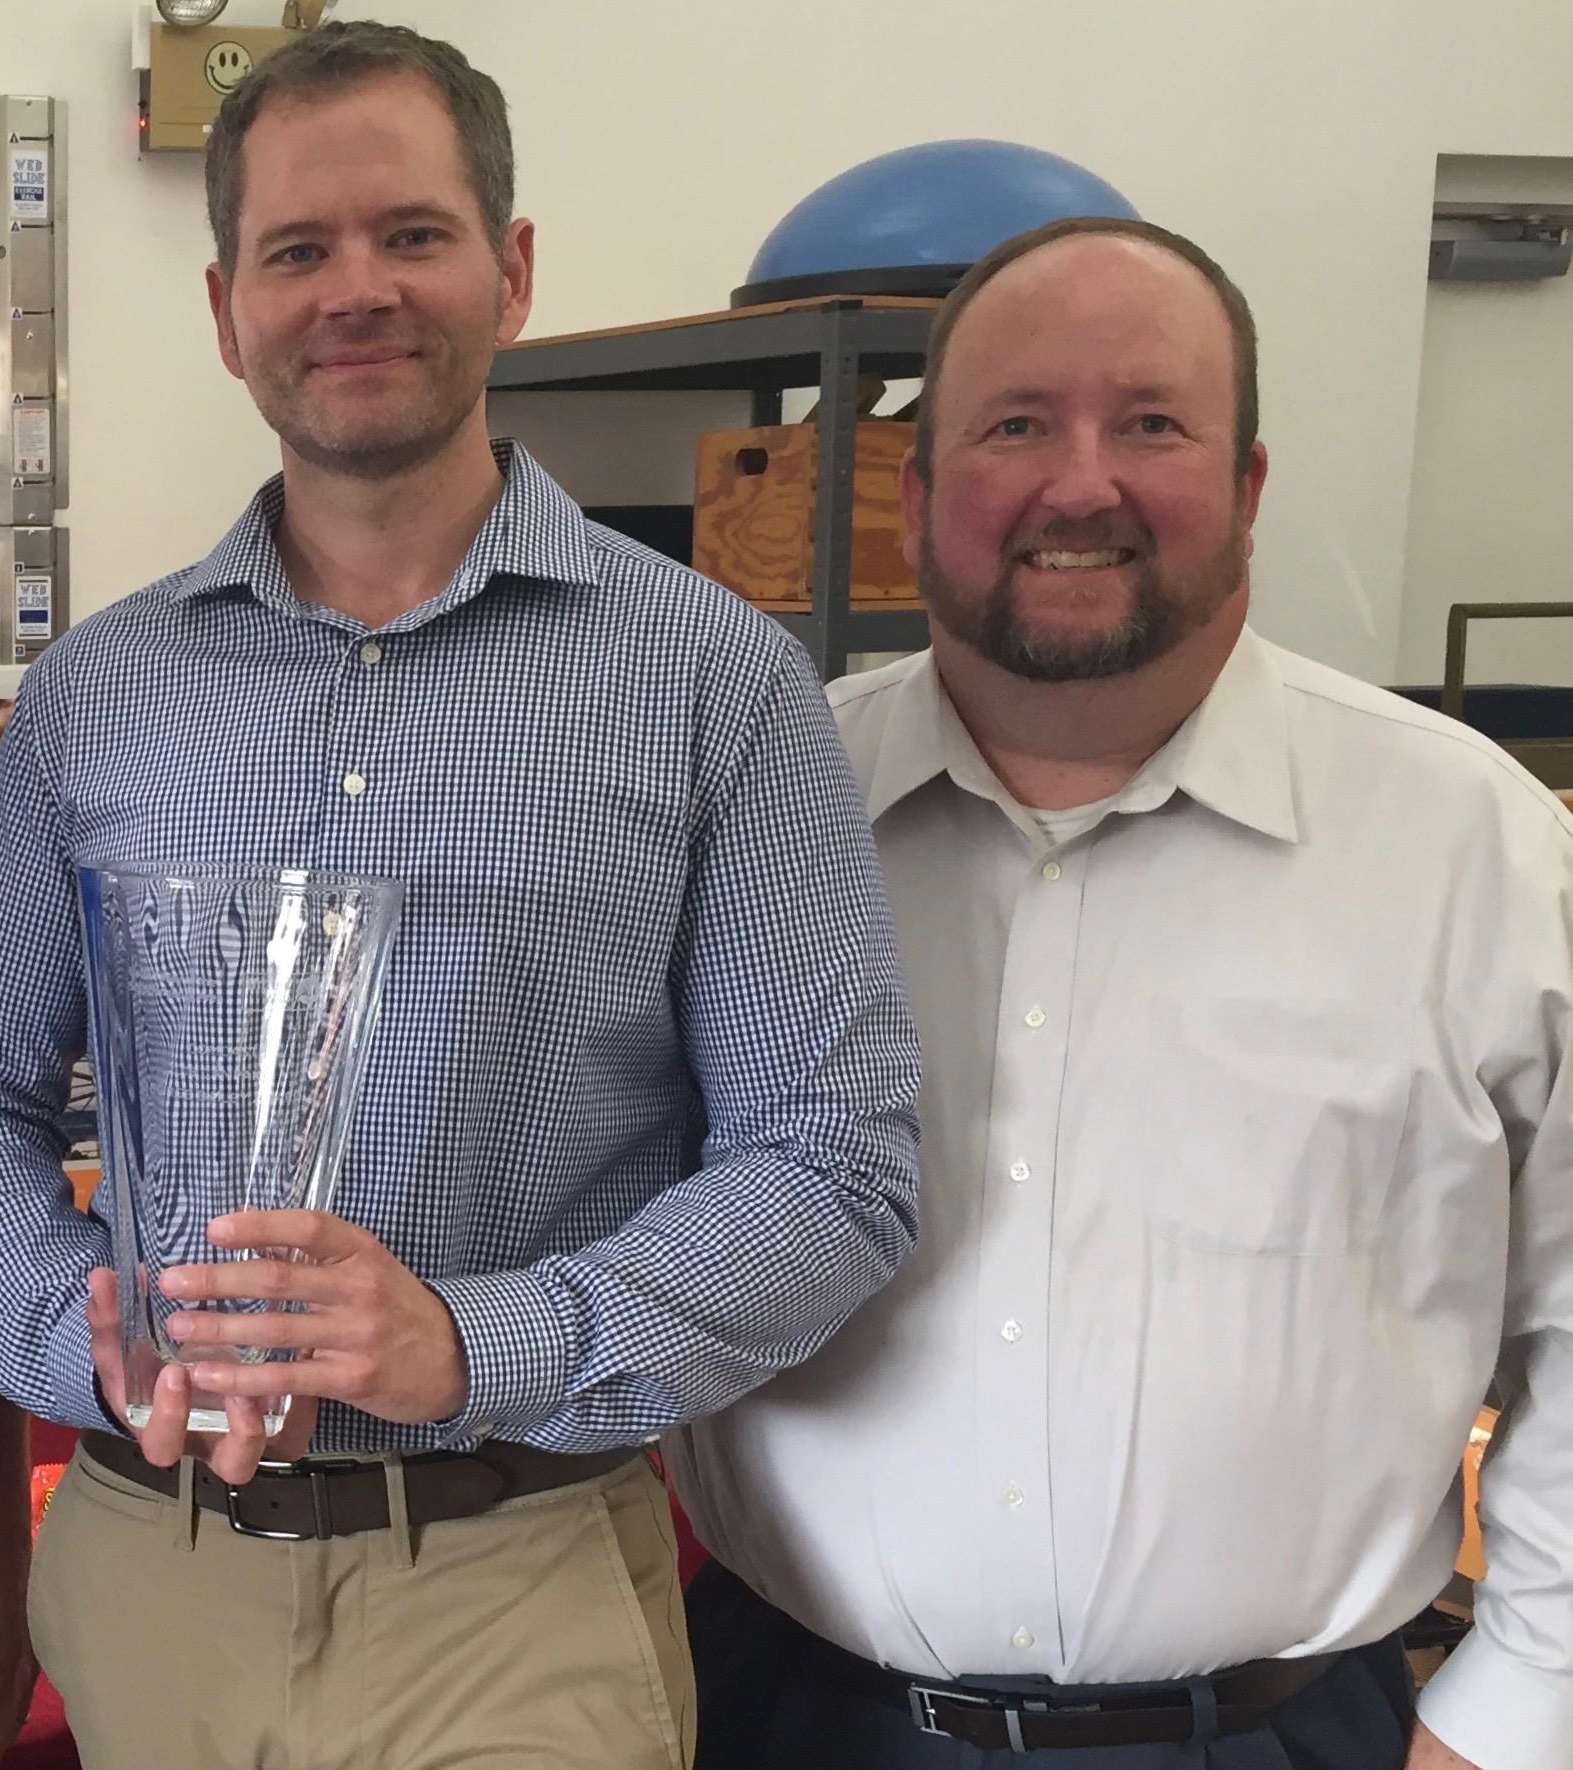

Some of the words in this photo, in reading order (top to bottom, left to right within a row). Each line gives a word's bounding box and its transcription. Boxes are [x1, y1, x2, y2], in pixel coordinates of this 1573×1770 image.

[15, 159, 42, 171] WEB
[13, 172, 44, 184] SLIDE
[20, 584, 46, 595] WEB
[18, 597, 48, 607] SLIDE
